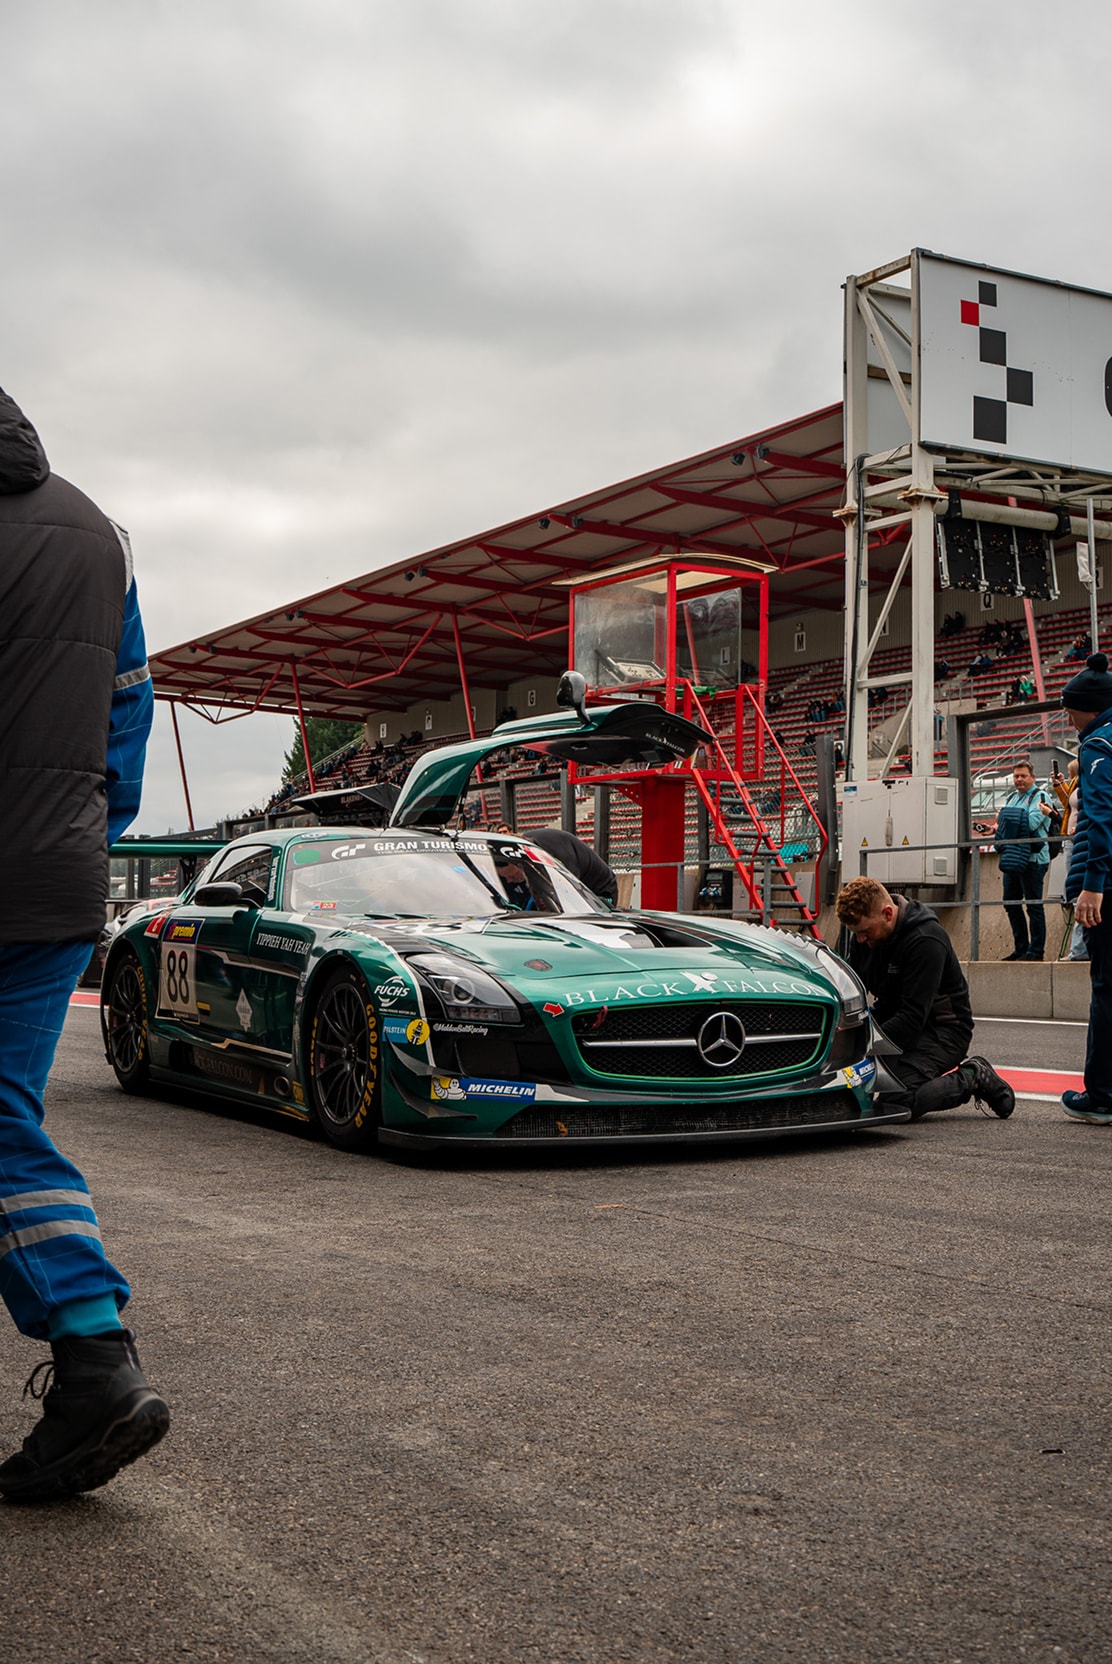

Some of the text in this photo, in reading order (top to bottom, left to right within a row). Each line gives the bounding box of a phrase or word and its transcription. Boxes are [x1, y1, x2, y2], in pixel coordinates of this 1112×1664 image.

[373, 841, 418, 852] GRAN
[421, 840, 488, 852] TURISMO
[171, 923, 195, 940] premio
[167, 950, 189, 1004] 88
[374, 985, 411, 997] FUCHS
[562, 978, 823, 1006] BLACK FALCON
[355, 1003, 378, 1129] GOODYEAR
[467, 1083, 535, 1096] MICHELIN
